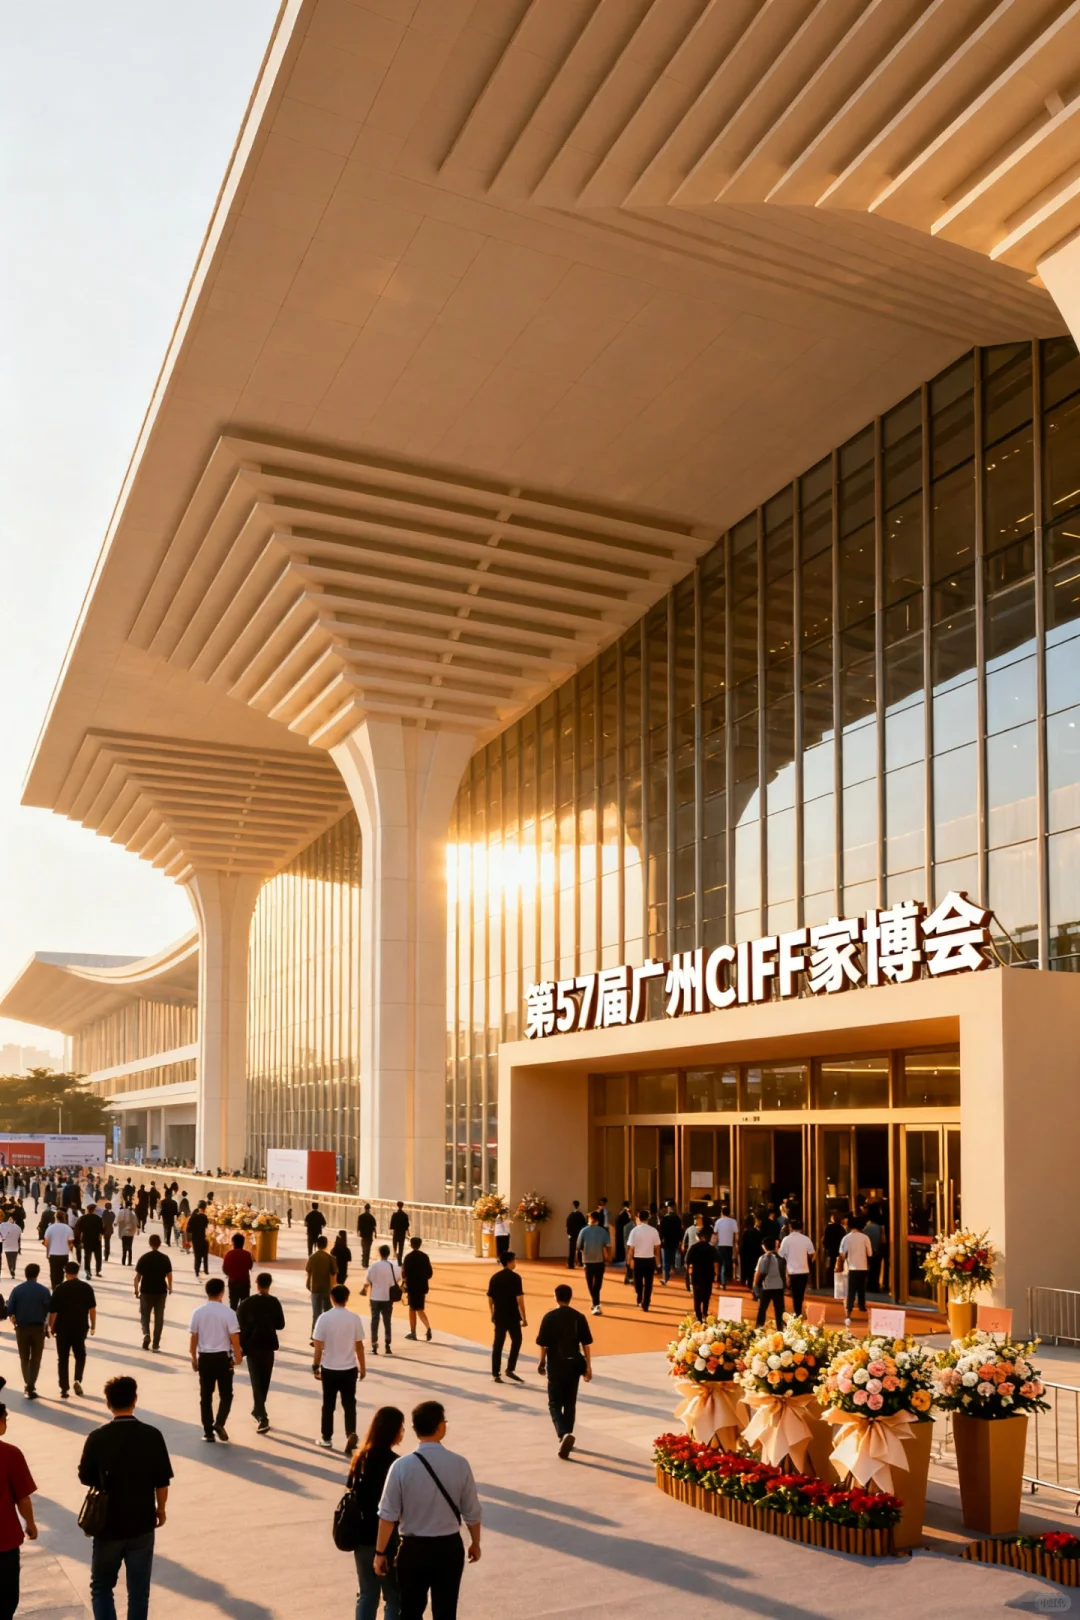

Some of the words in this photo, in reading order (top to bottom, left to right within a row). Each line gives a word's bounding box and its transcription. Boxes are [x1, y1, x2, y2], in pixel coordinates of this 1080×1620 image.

[523, 890, 990, 1039] 第57届广州CIFF家博会
